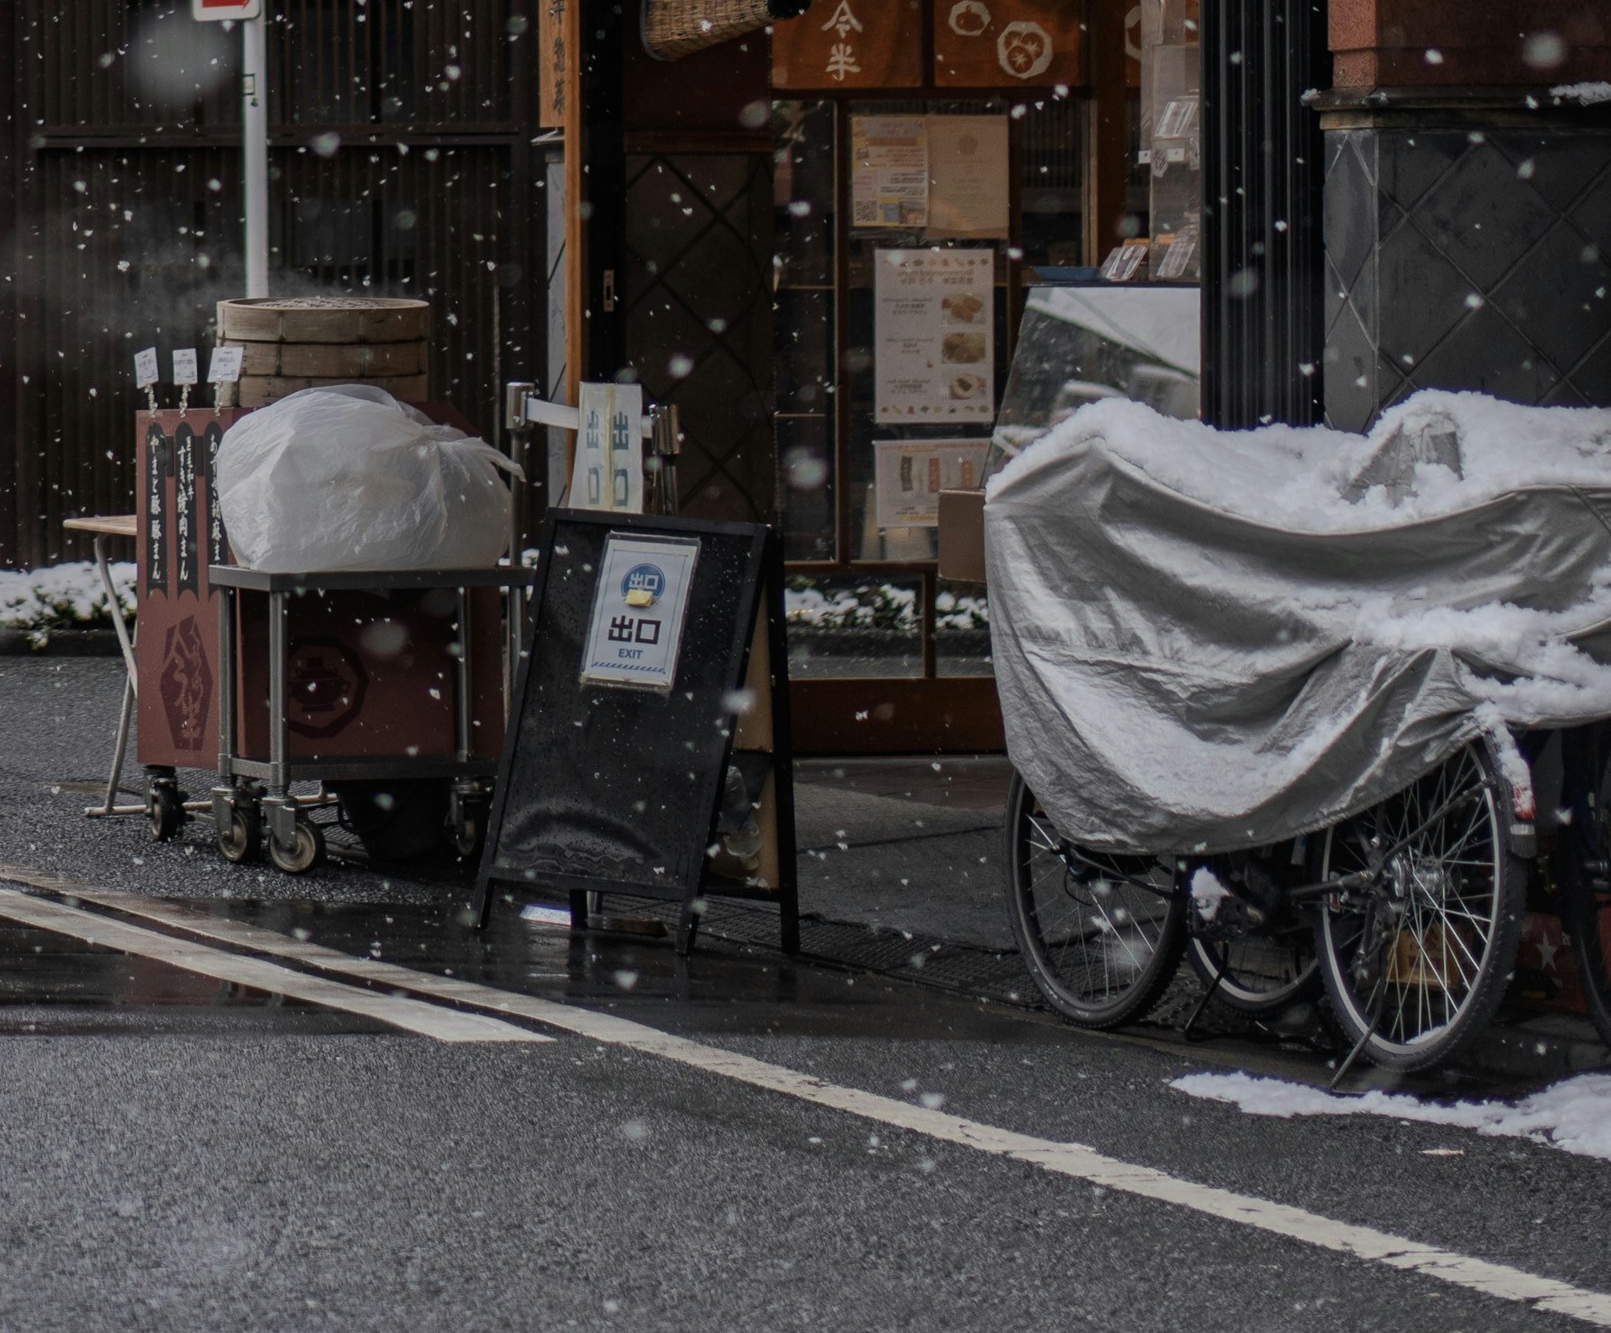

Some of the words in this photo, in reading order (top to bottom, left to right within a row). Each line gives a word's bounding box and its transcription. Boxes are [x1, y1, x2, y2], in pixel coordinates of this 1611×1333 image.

[820, 0, 864, 81] 今半
[628, 572, 659, 590] 出口
[608, 615, 661, 645] 出口
[618, 648, 644, 660] EXIT
